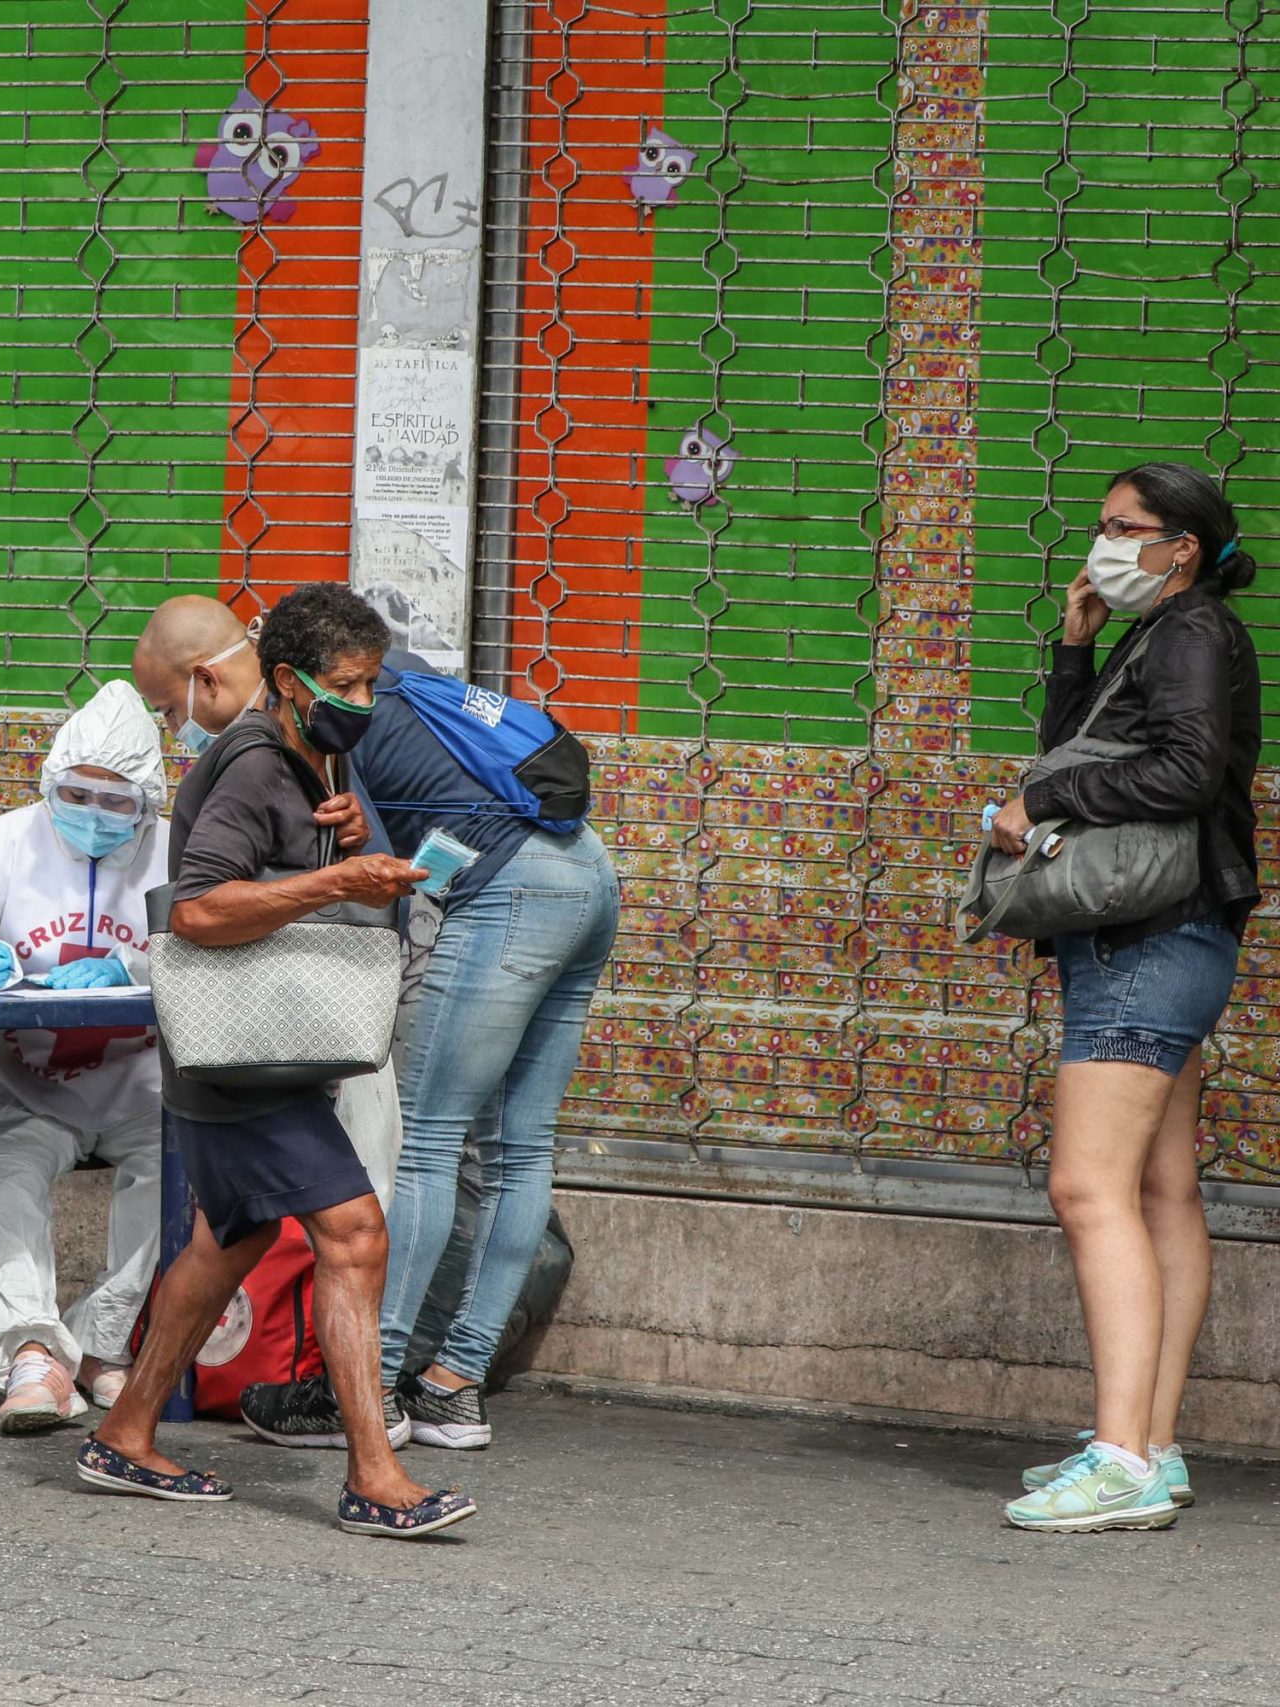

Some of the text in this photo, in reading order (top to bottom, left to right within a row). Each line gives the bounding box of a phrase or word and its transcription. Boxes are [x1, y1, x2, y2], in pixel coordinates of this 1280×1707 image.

[371, 411, 456, 430] ESPÍRITU de
[15, 912, 150, 960] CRUZ ROJ
